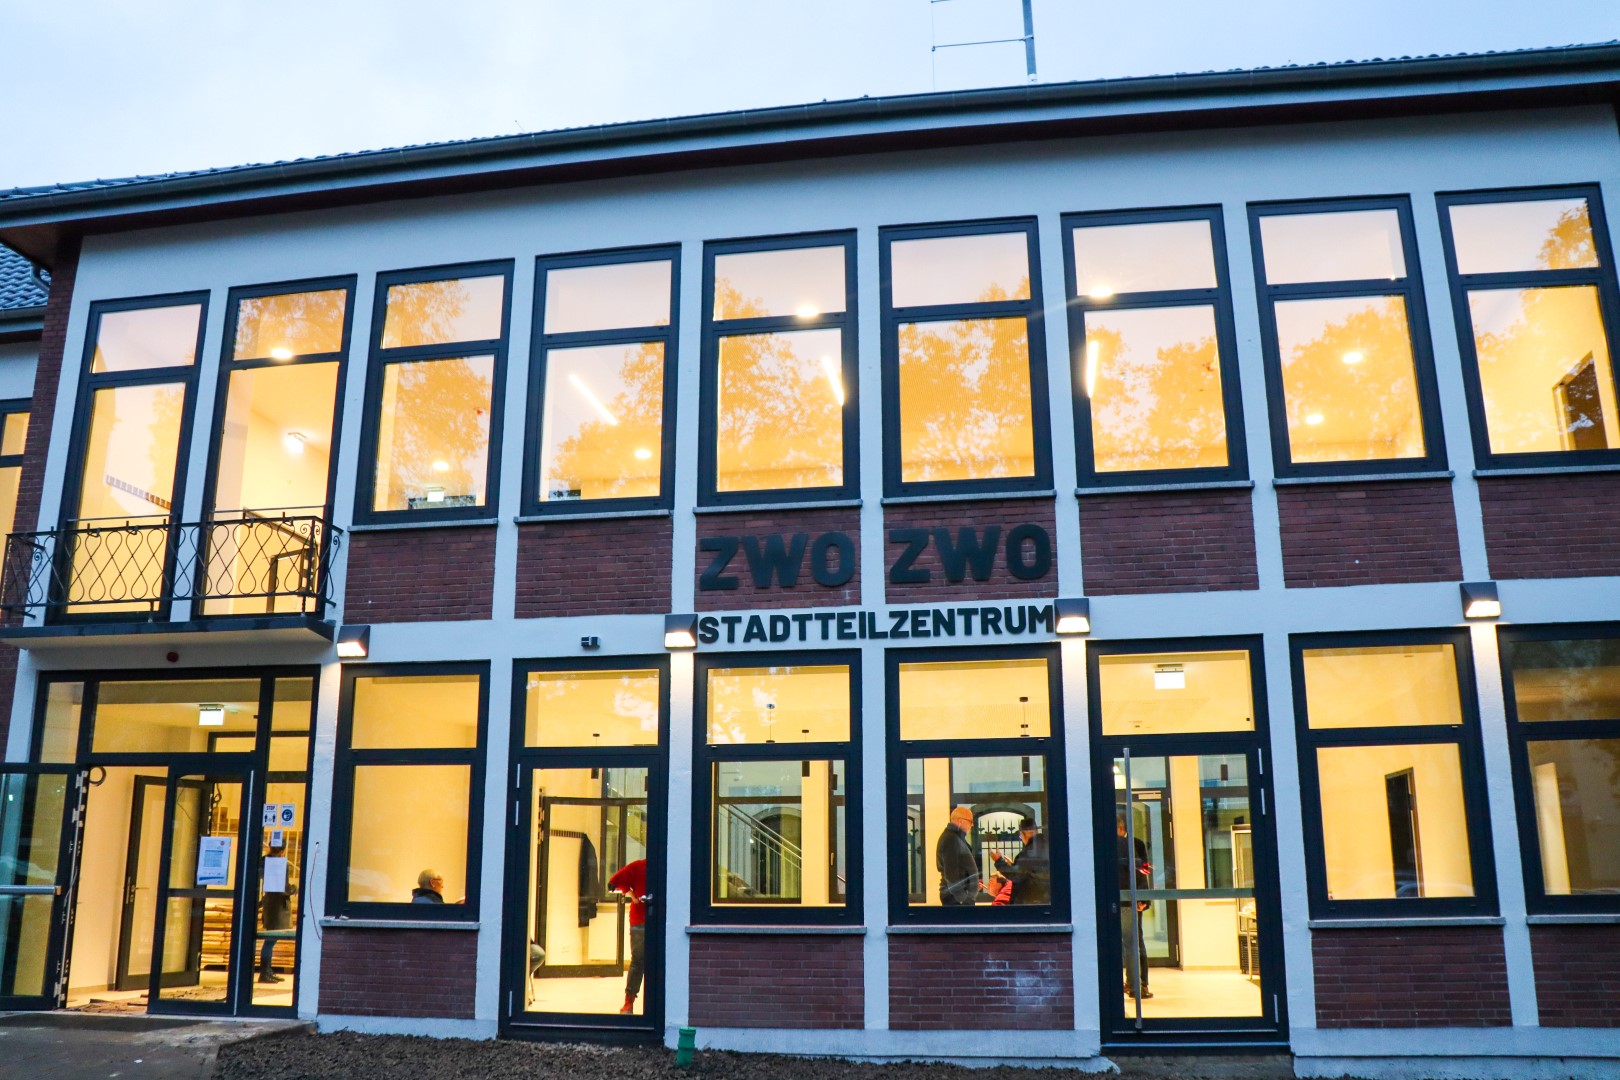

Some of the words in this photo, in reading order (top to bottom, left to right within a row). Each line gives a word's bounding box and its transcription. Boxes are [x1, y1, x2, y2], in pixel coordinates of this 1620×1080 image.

[700, 532, 855, 590] ZWO
[889, 524, 1052, 583] ZWO
[699, 605, 1054, 643] STADTTEILZENTRUM
